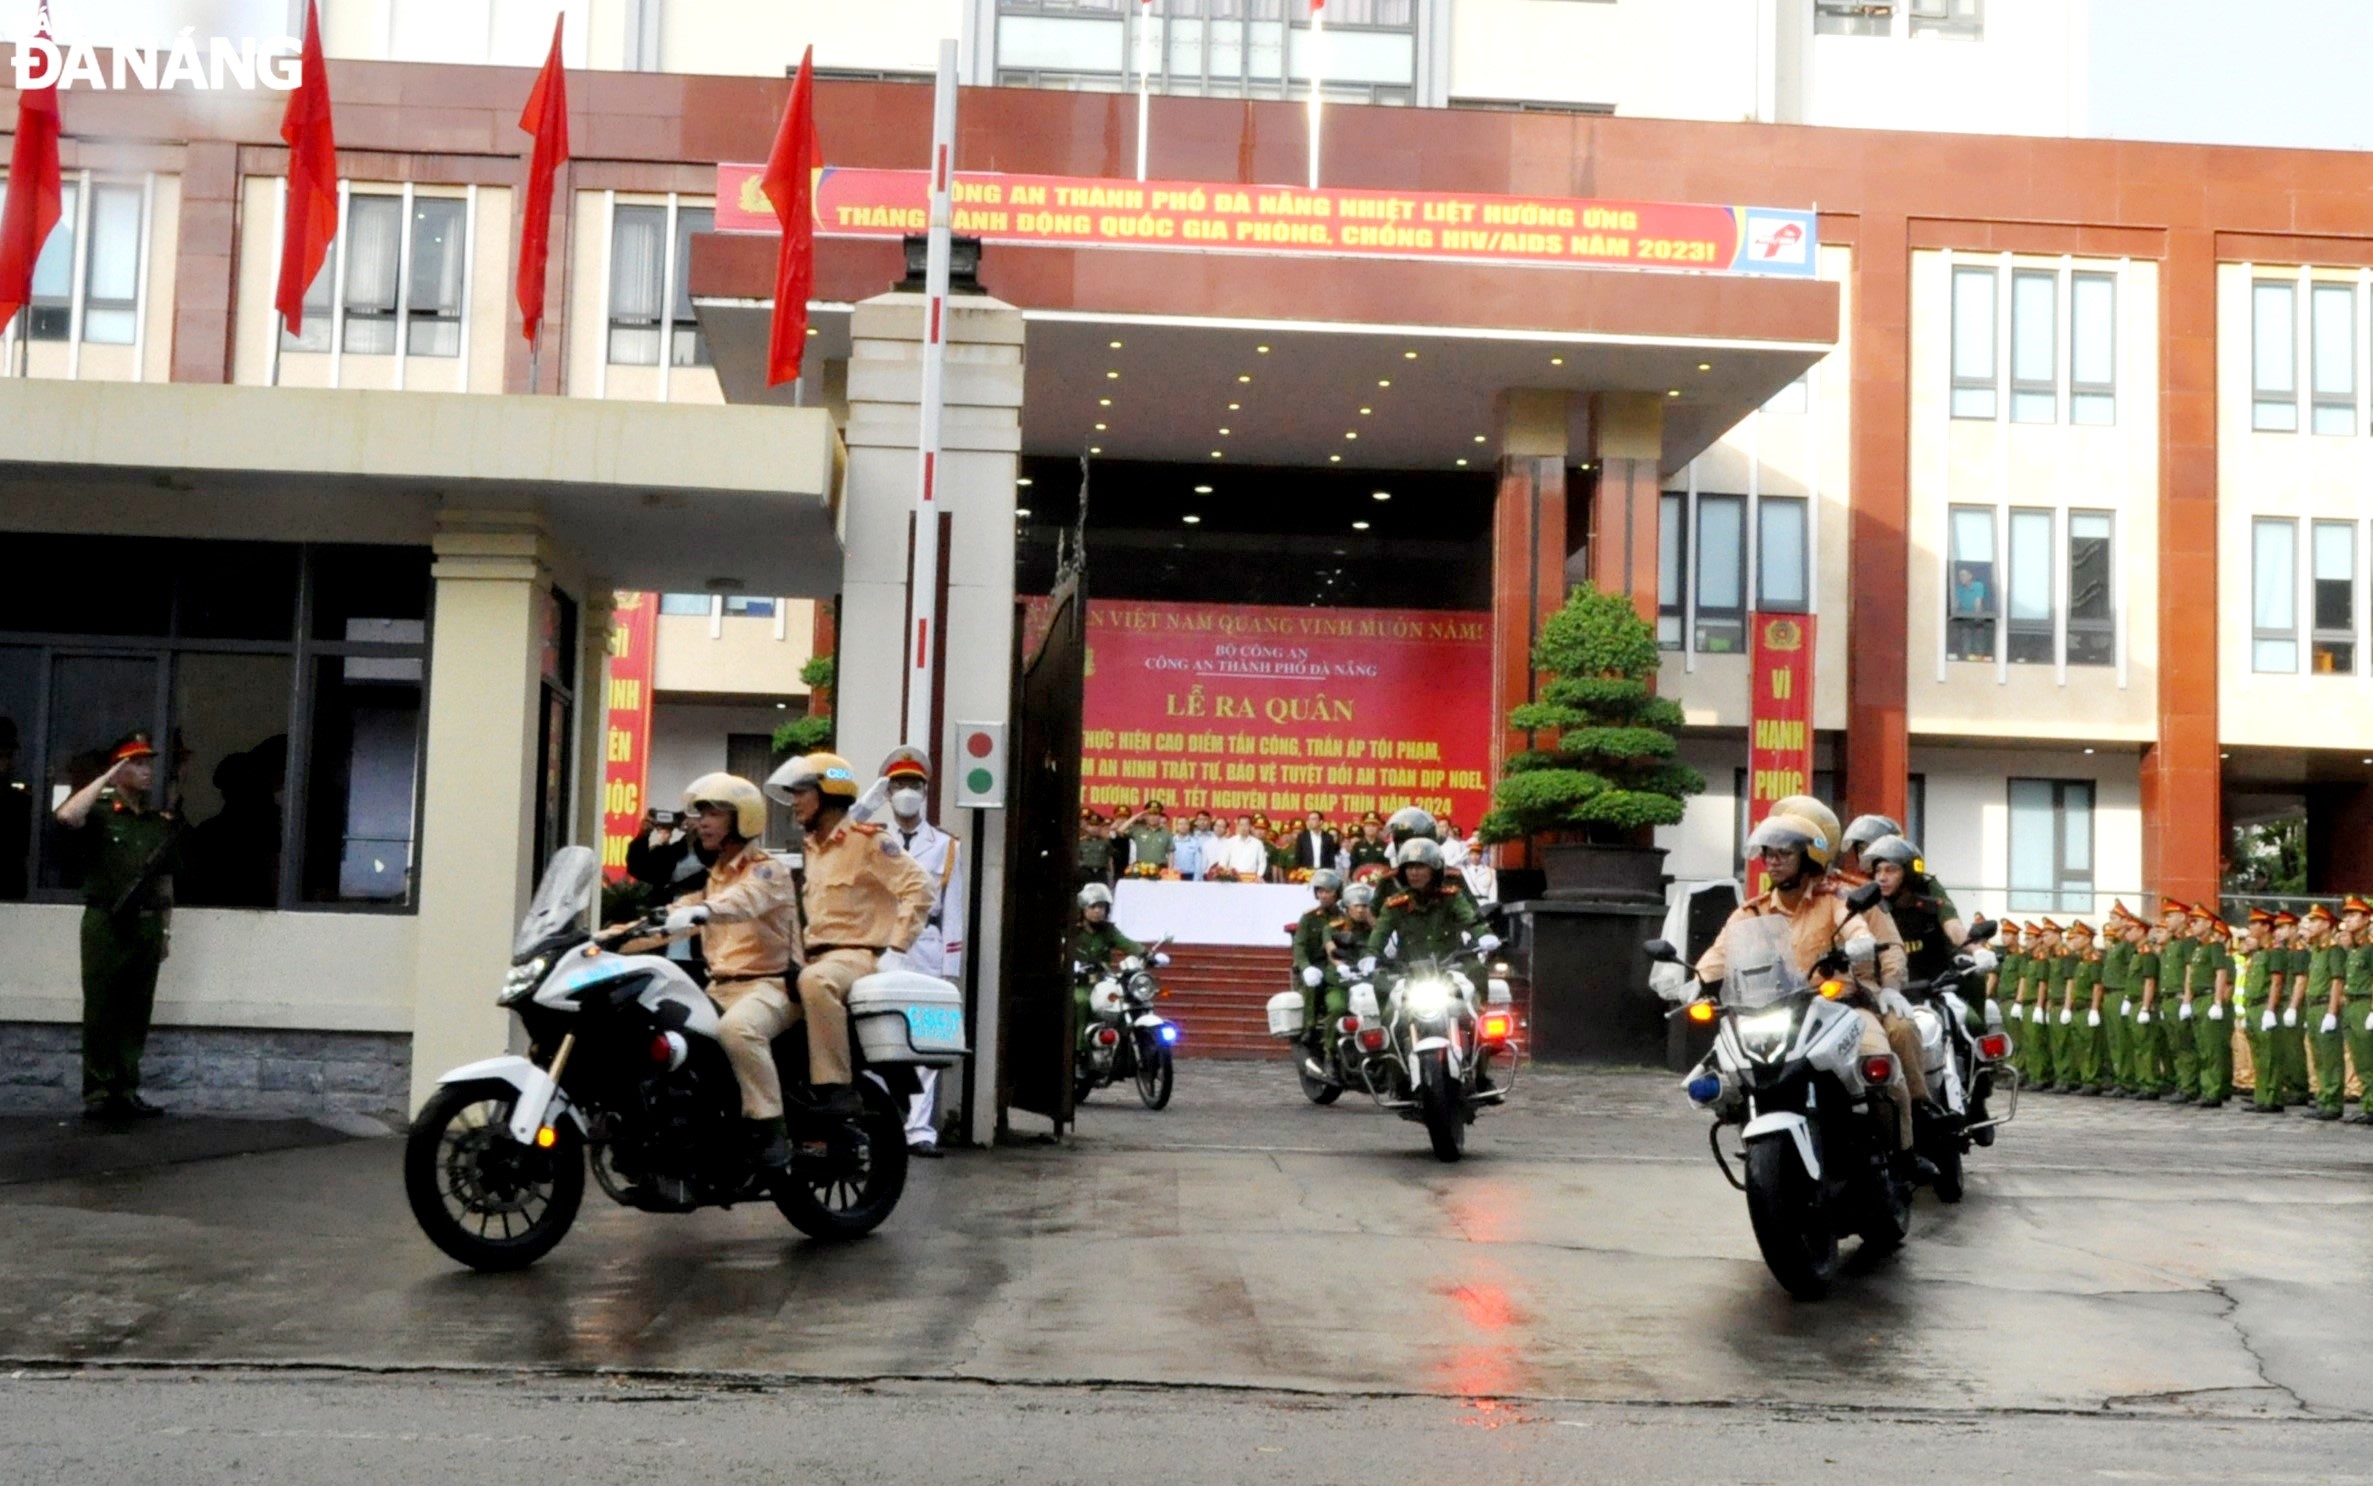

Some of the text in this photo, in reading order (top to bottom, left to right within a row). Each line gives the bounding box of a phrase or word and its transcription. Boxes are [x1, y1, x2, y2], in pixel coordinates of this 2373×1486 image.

[1010, 185, 1046, 205] AN
[1054, 186, 1143, 209] THÀNH
[1152, 186, 1206, 211] PHỐ
[1214, 191, 1250, 213] ĐÀ
[1339, 197, 1416, 222] NHIỆT
[1423, 199, 1476, 225] LIỆT
[837, 206, 926, 228] THÁNG
[952, 208, 1008, 231] ÀNH
[1016, 211, 1091, 236] ĐỘNG
[1100, 211, 1174, 238] QUỐC
[1182, 218, 1228, 240] GIA
[1341, 220, 1433, 248] CHỐNG
[1442, 229, 1562, 255] HIV/AIDS
[1571, 233, 1630, 257] NĂM
[1637, 238, 1716, 262] 2023!
[1109, 608, 1161, 633] VIỆT
[1166, 612, 1212, 631] NAM
[1218, 615, 1293, 634] QUANG
[1300, 617, 1352, 636] VINH
[1144, 655, 1189, 670] CÔNG
[1193, 659, 1213, 671] AN
[1219, 658, 1271, 673] THÀNH
[1274, 657, 1306, 674] PHỐ
[1215, 643, 1309, 660] BỘ CÔNG AN
[1772, 664, 1790, 699] VÌ
[1166, 683, 1354, 725] LỄ RA QUÂN
[1119, 729, 1151, 754] HIỆN
[1155, 732, 1184, 752] CAO
[1347, 736, 1365, 759] ÁP
[1370, 737, 1392, 762] TỘI
[1756, 719, 1804, 756] HẠNH
[1099, 758, 1118, 777] AN
[1122, 759, 1157, 779] NINH
[1161, 758, 1197, 783] TRẬT
[1356, 766, 1375, 786] AN
[1380, 765, 1417, 788] TOÀN
[1450, 770, 1486, 792] NOEL,
[1755, 765, 1804, 800] PHÚC
[1184, 782, 1208, 807] TẾT
[1212, 787, 1267, 810] NGUYÊN
[1304, 790, 1338, 812] GIÁP
[1342, 792, 1375, 813] THÌN
